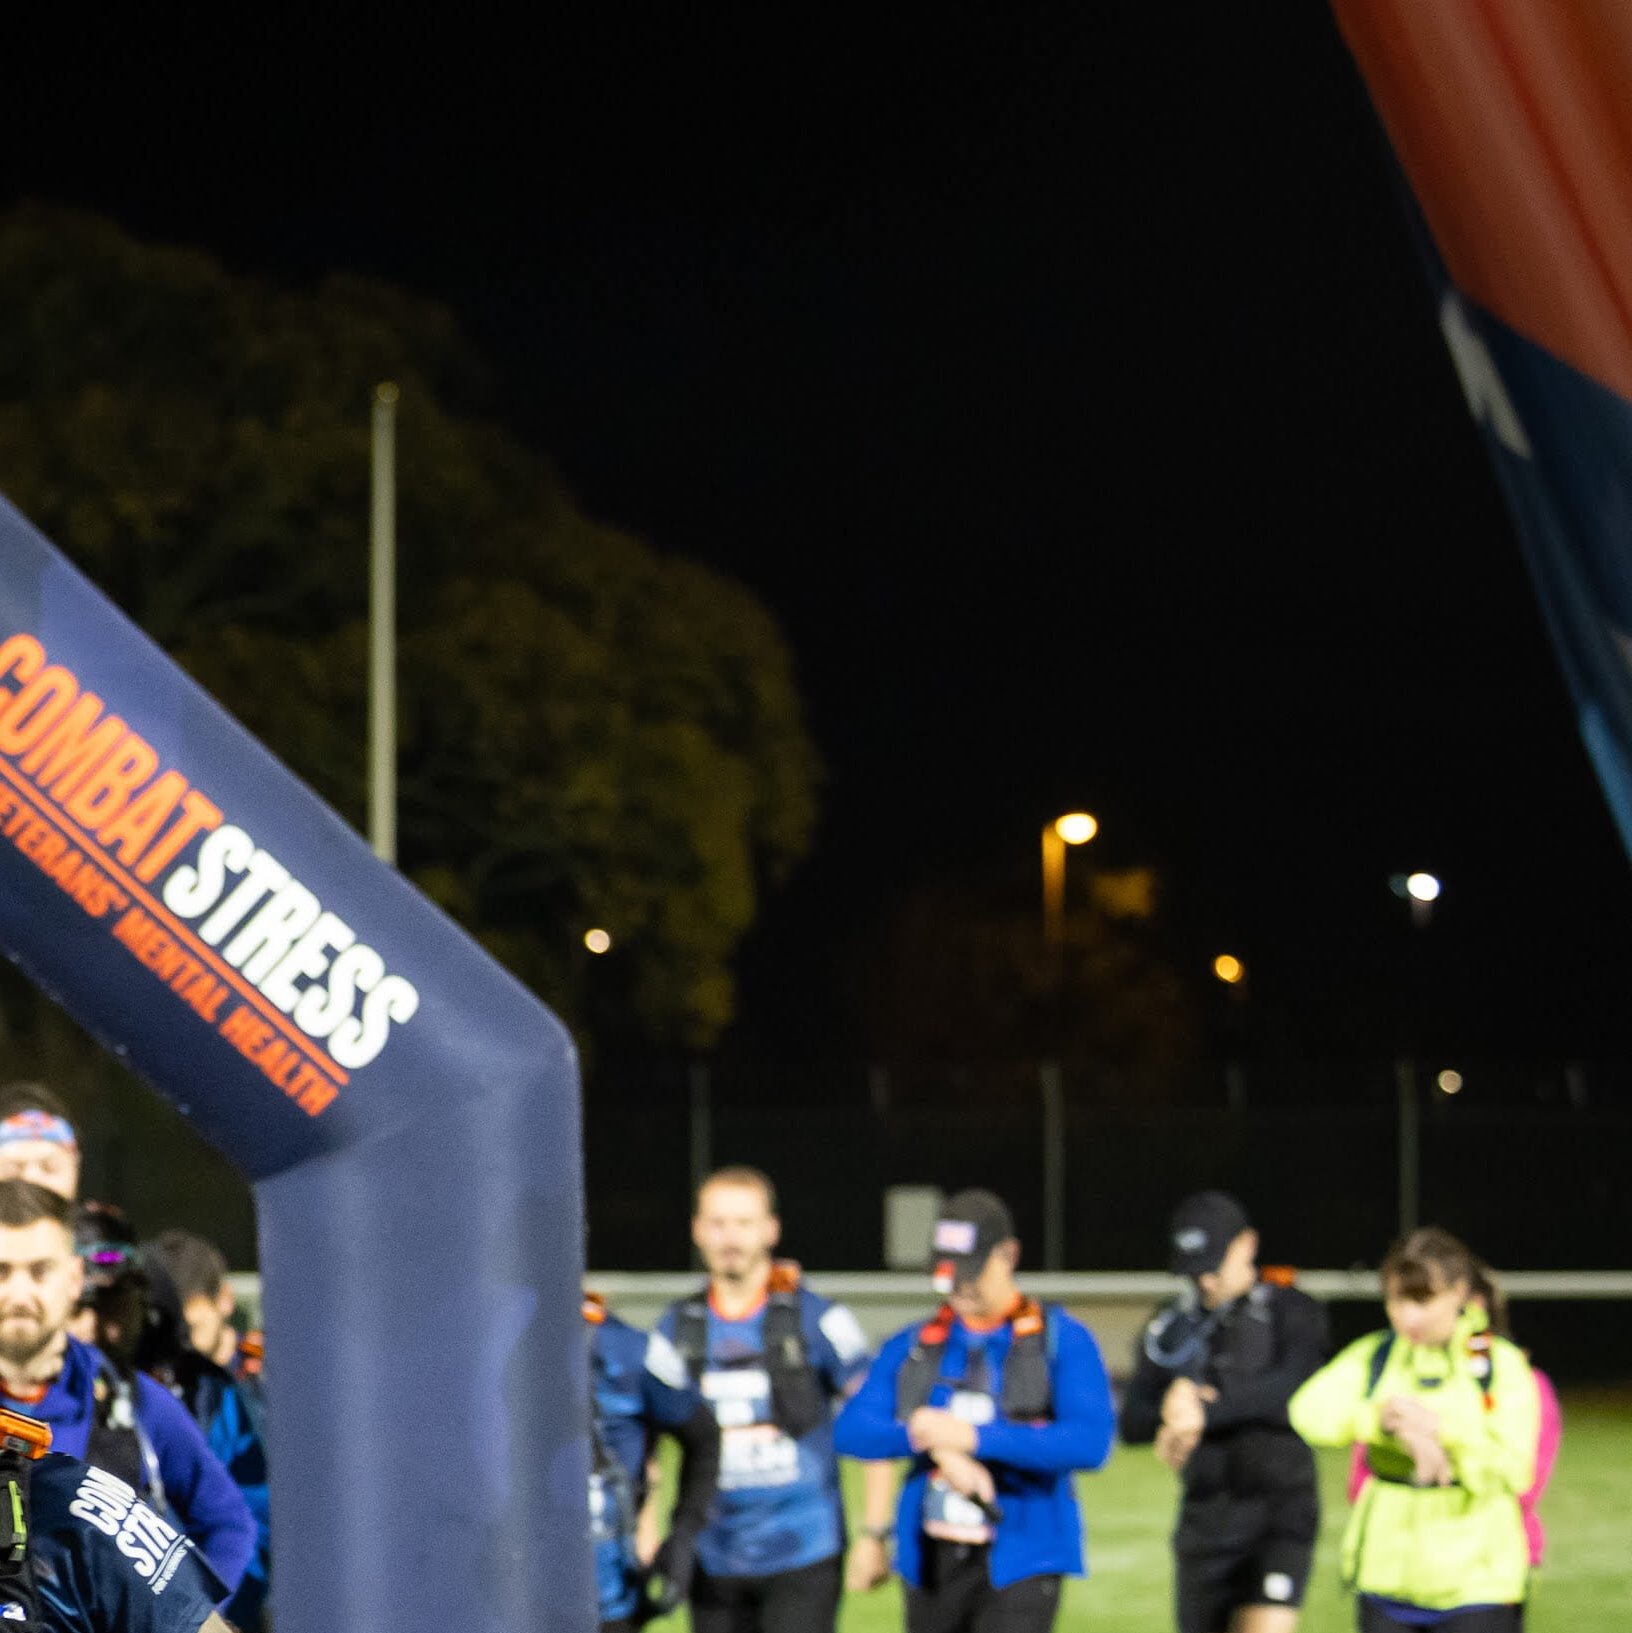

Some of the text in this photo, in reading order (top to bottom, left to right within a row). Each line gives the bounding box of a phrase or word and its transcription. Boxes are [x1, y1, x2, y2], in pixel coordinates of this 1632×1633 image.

[112, 906, 230, 1024] MENTAL
[219, 1002, 340, 1118] HEALTH
[116, 1502, 178, 1577] STR
